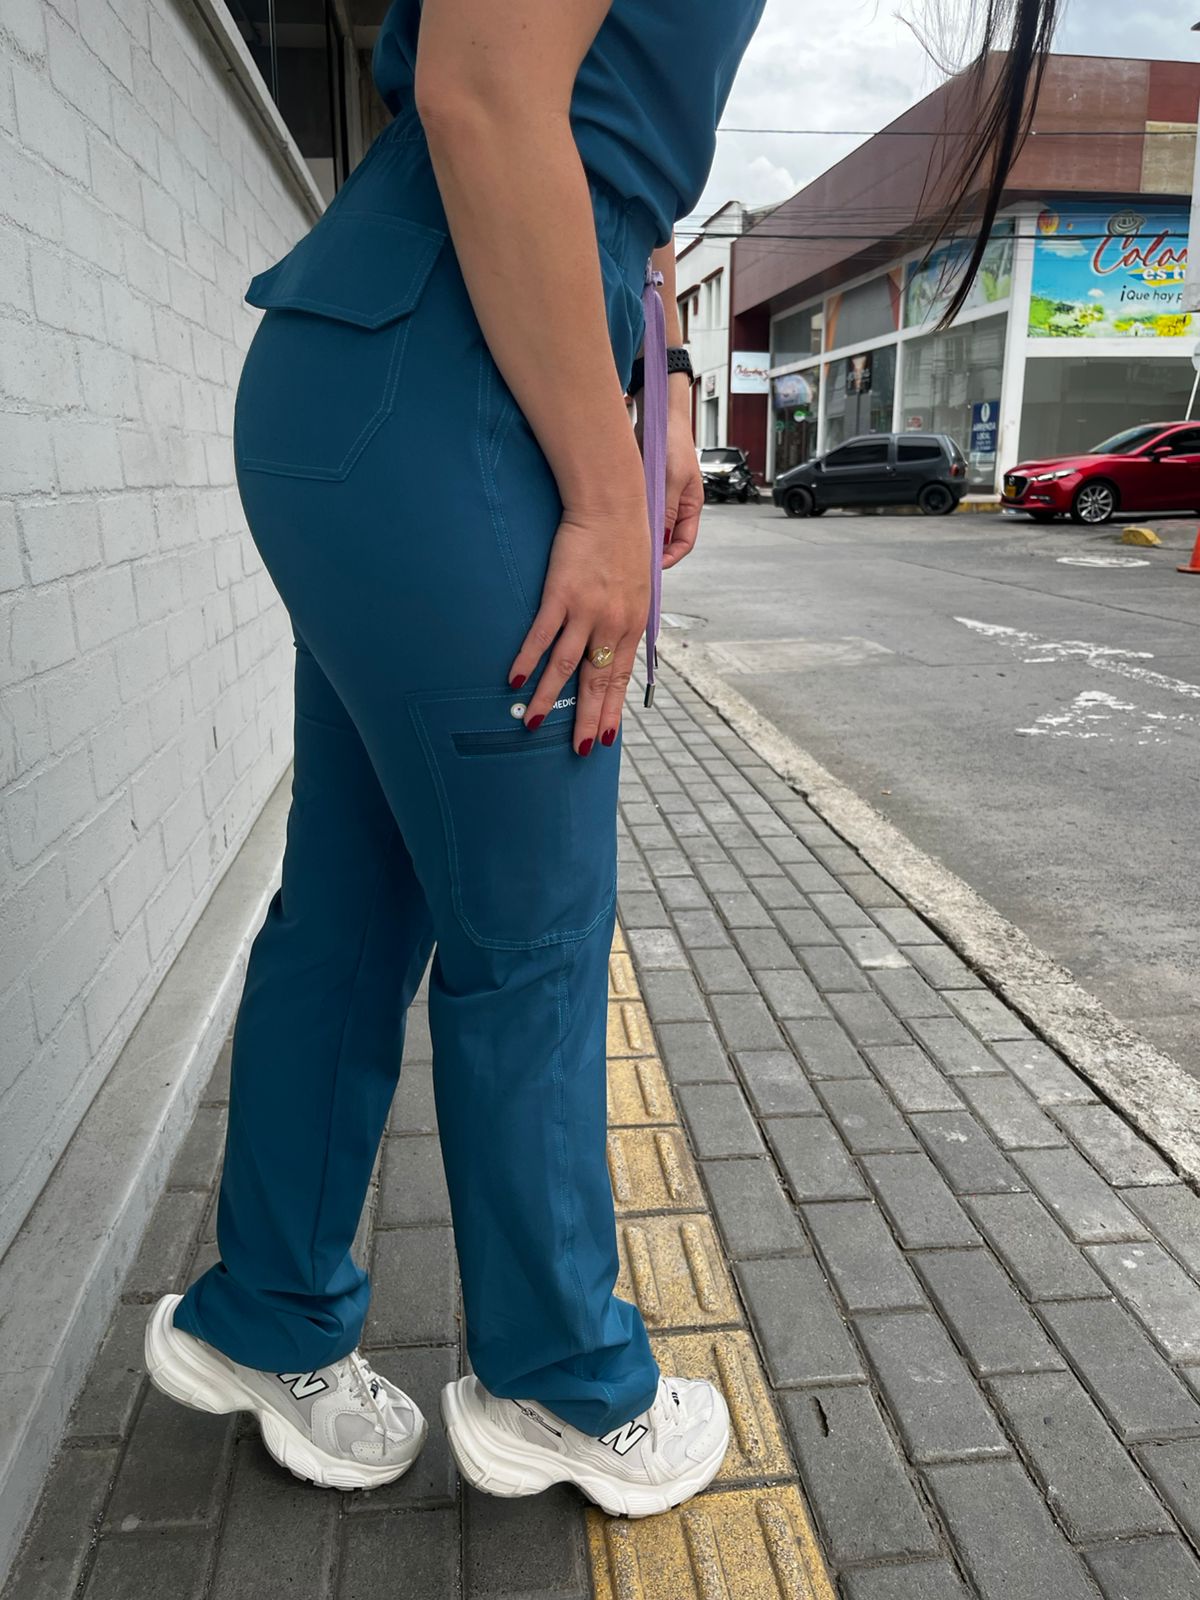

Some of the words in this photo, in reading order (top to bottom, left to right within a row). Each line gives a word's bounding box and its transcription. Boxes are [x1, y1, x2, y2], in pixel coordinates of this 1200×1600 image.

[1143, 268, 1167, 280] es
[1152, 289, 1175, 304] hay
[598, 1420, 649, 1457] N
